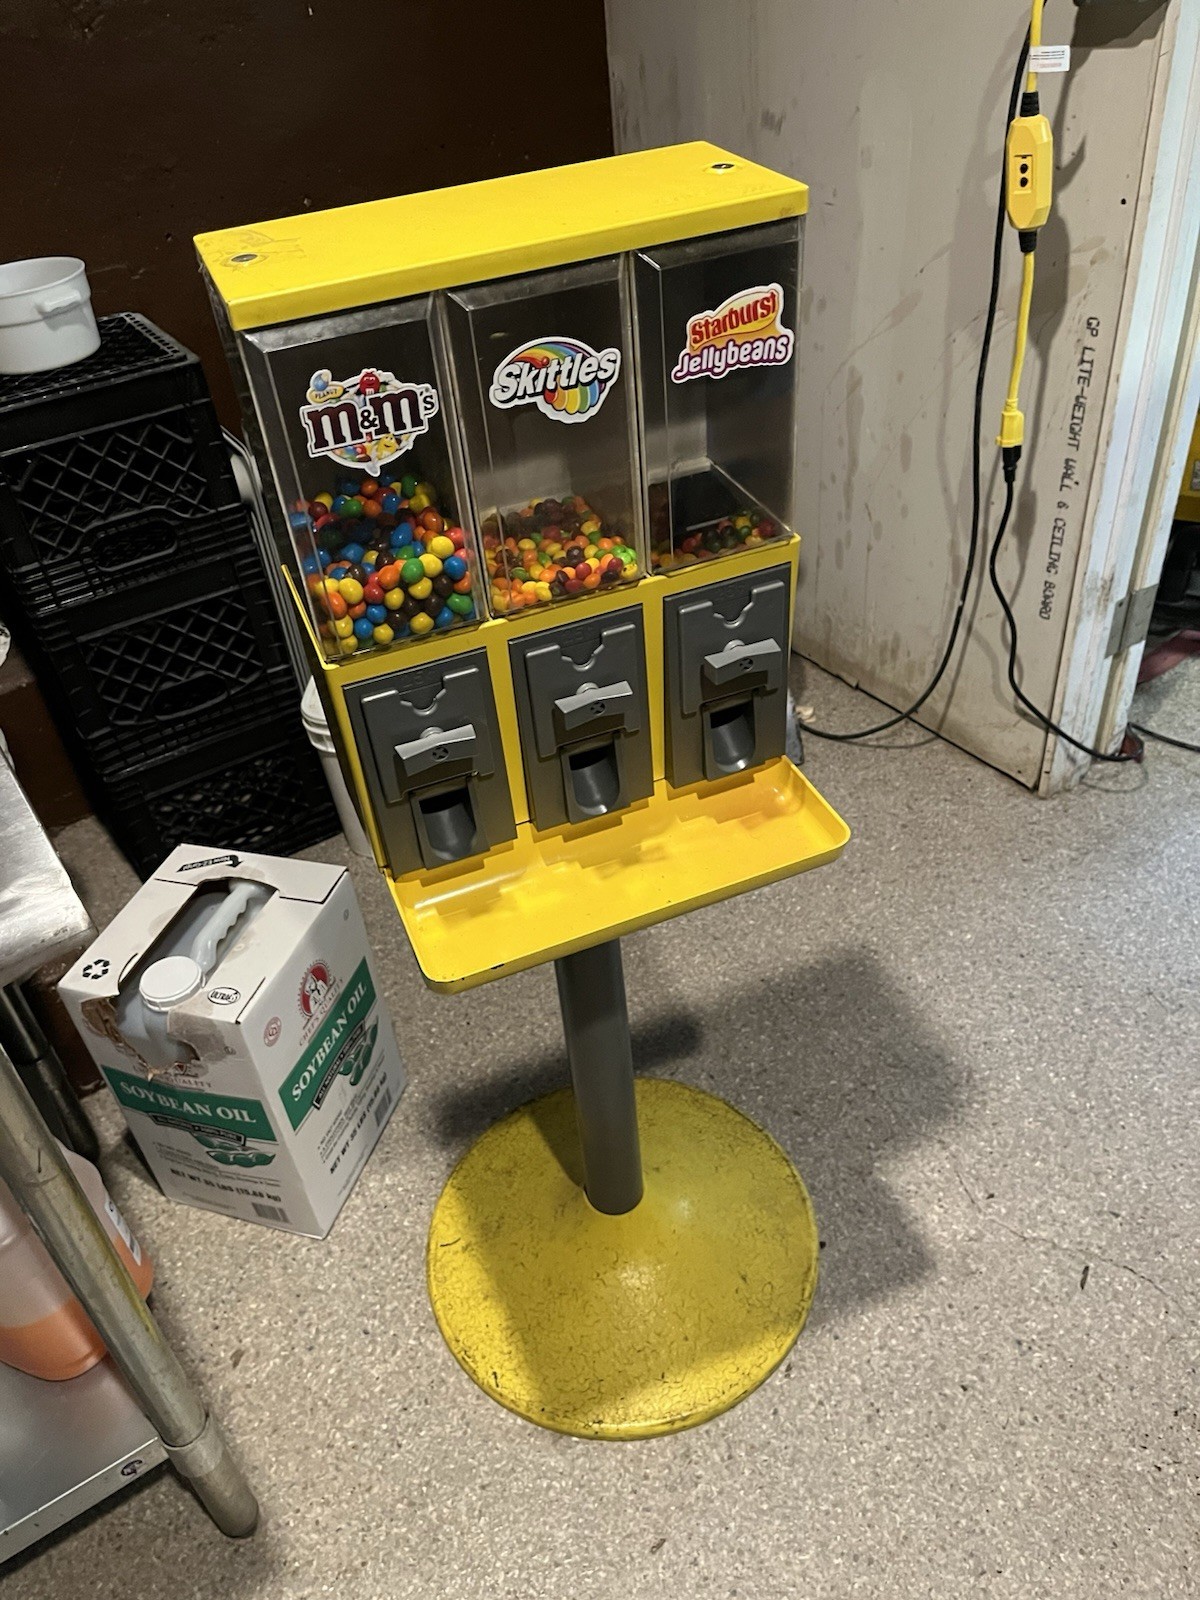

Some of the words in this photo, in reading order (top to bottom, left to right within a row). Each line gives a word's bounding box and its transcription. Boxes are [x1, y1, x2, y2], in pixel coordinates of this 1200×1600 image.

[691, 291, 777, 344] Starburst
[1086, 316, 1100, 337] GP
[494, 352, 618, 402] Skittles
[675, 336, 789, 378] Jellybeans
[314, 388, 339, 400] PEANUT
[1067, 346, 1096, 452] LITE-WEIGHT
[1059, 457, 1077, 492] WALL
[1046, 517, 1066, 575] CEILING
[1039, 580, 1056, 621] BOARD
[291, 1009, 348, 1104] SOYBEAN
[345, 977, 367, 1017] OIL
[119, 1080, 213, 1117] SOYBEAN
[214, 1105, 256, 1124] OIL
